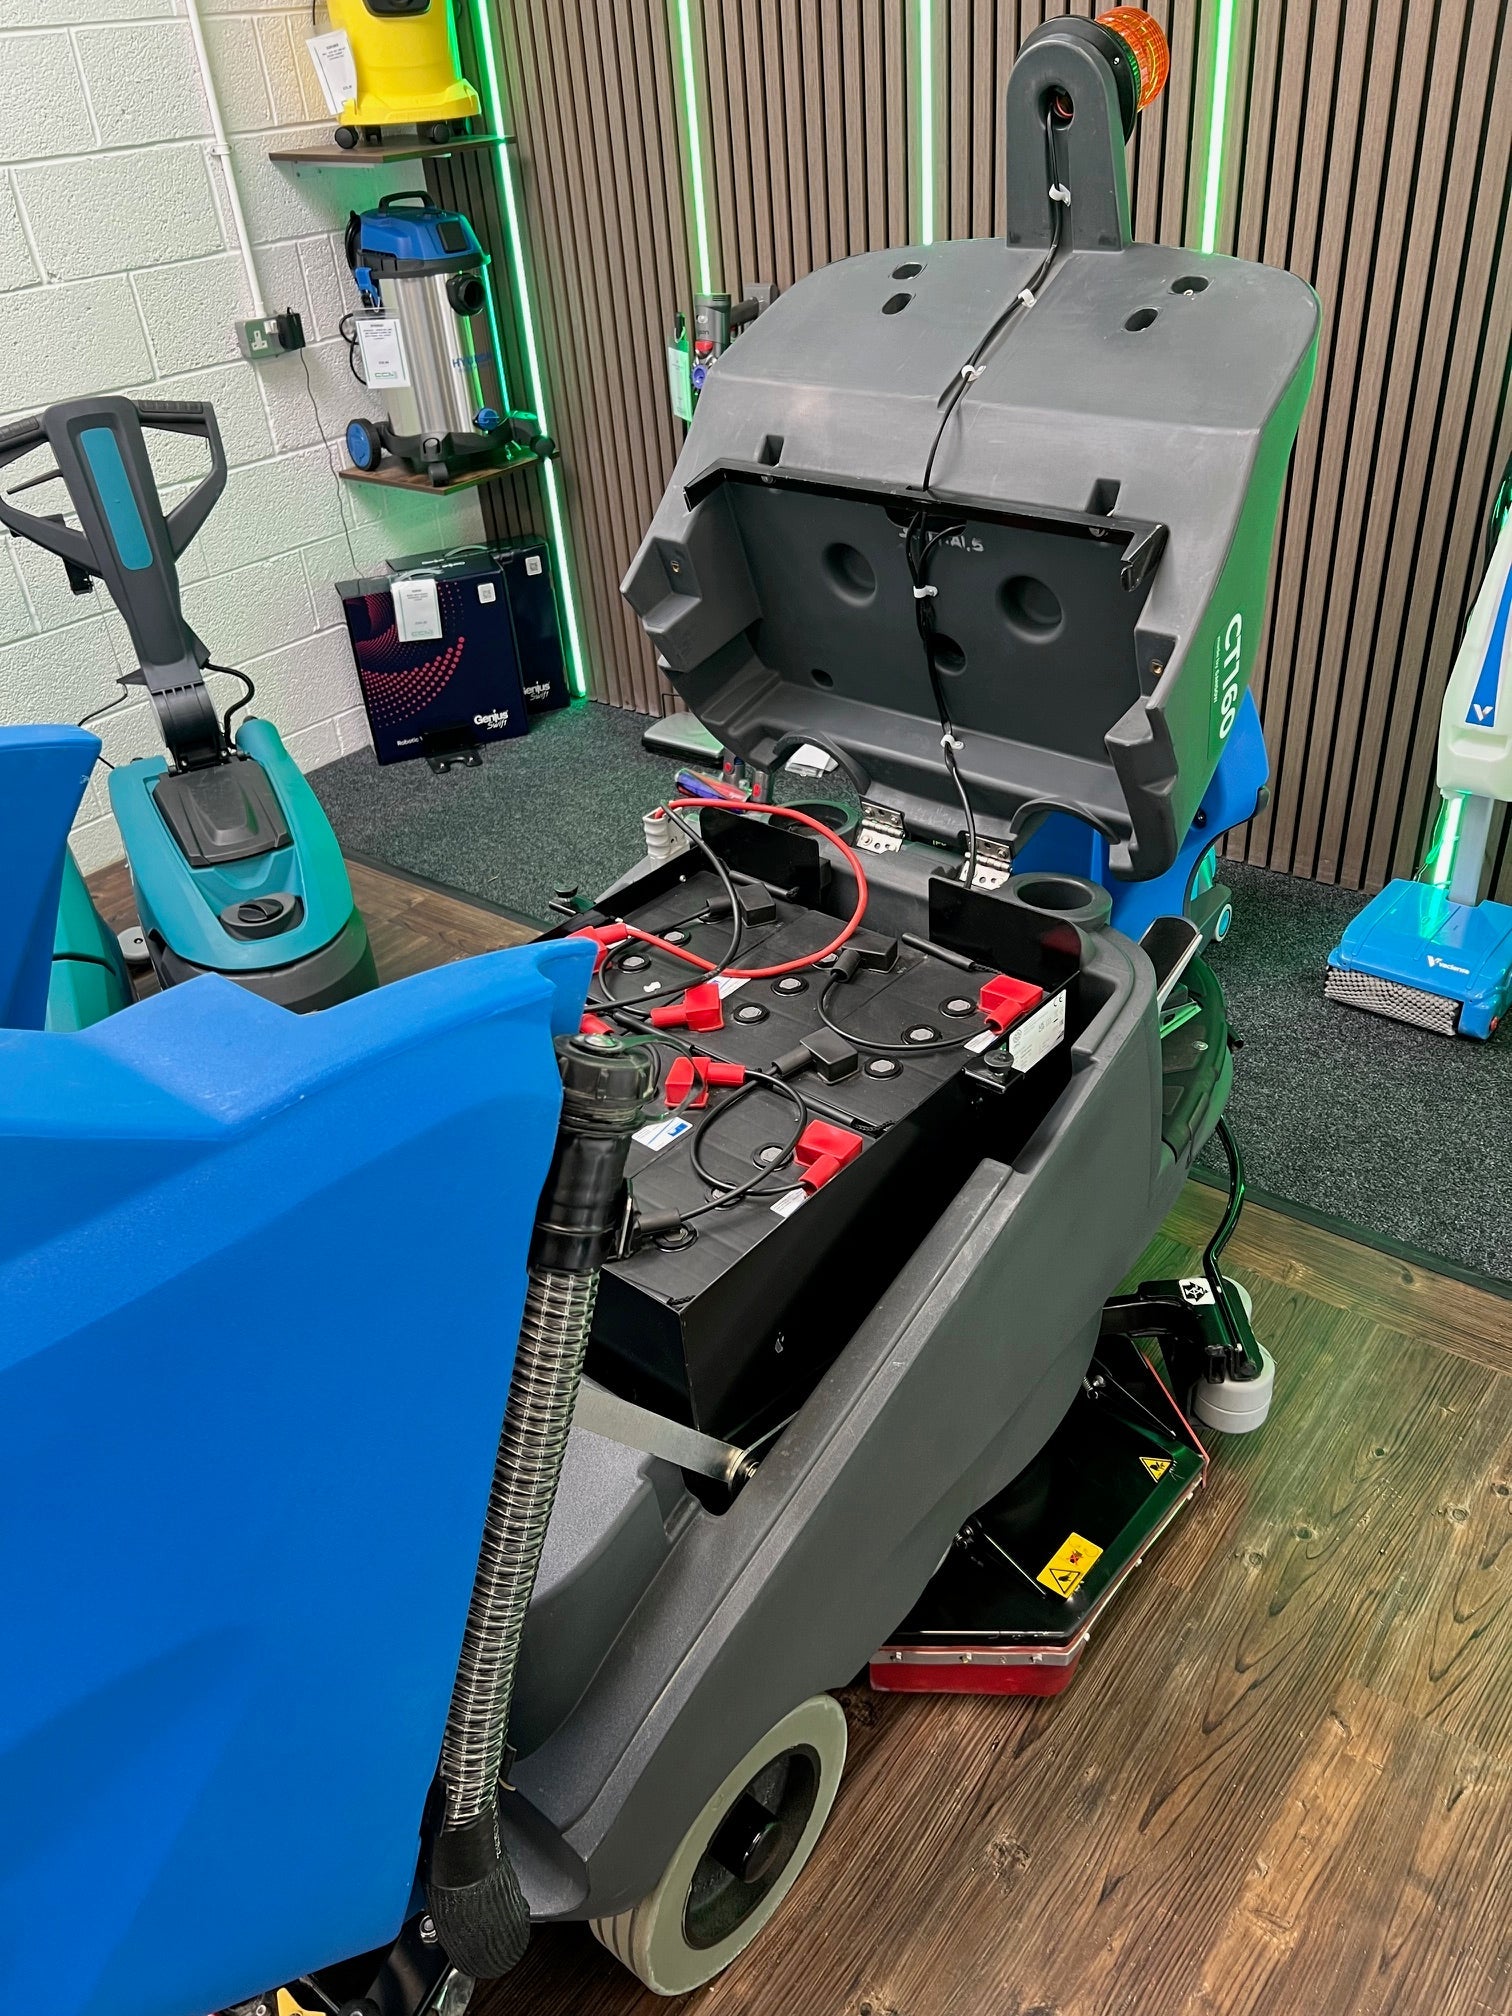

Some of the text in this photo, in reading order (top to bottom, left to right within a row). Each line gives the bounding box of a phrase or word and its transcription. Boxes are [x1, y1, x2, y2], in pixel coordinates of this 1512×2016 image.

[1219, 613, 1242, 739] CT160
[474, 709, 508, 725] Genius
[487, 719, 507, 730] Swift
